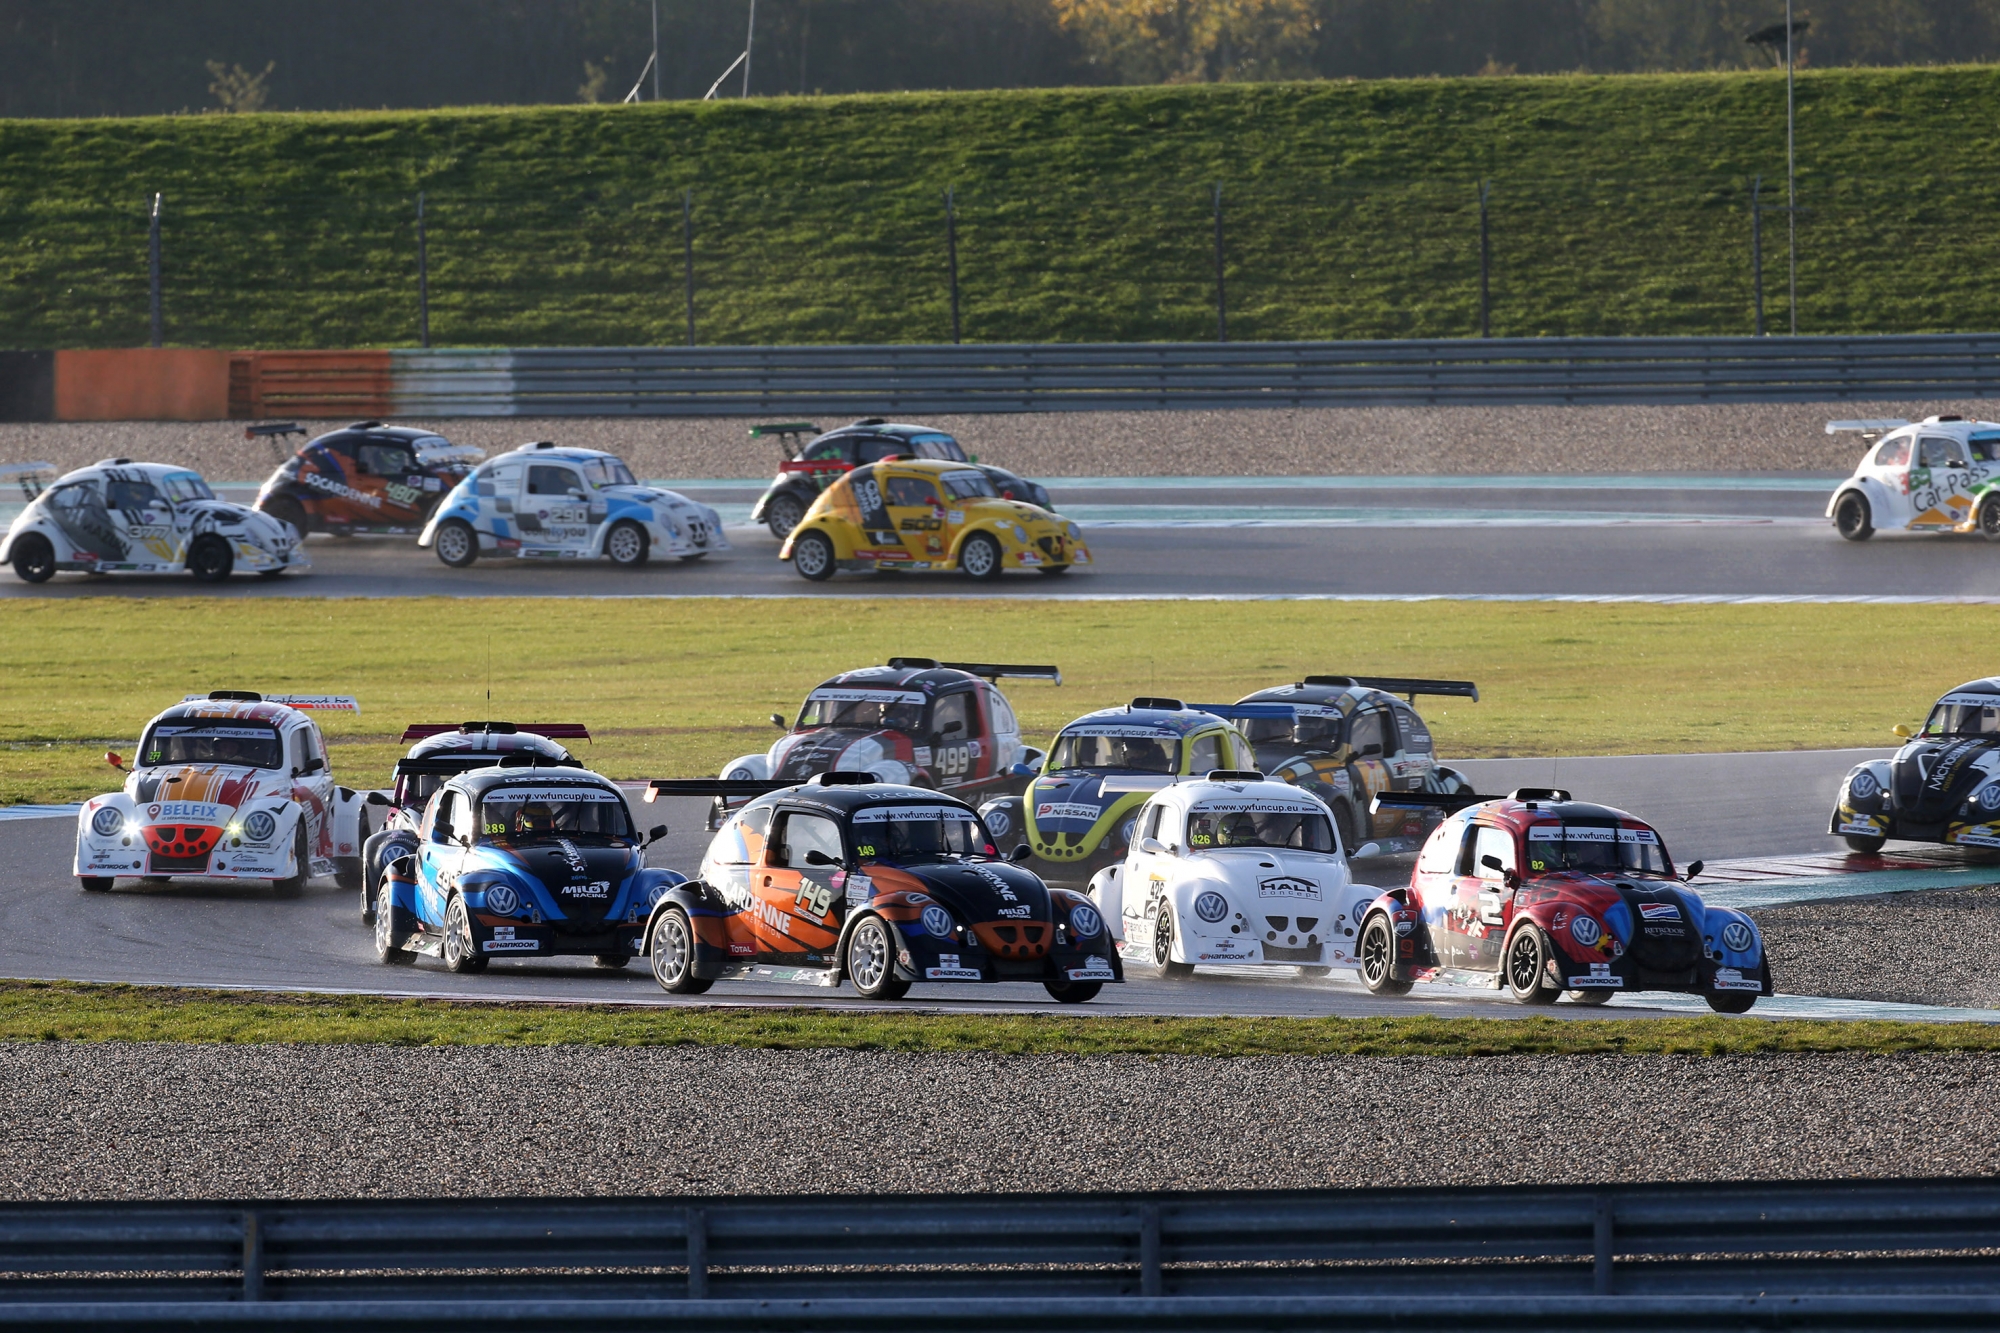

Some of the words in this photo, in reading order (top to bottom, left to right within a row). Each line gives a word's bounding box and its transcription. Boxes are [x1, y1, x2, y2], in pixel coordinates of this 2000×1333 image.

[1913, 465, 1990, 513] Car-Pass
[550, 508, 588, 524] 290
[129, 524, 171, 540] 377
[934, 746, 970, 775] 499
[162, 804, 218, 818] BELFIX
[1052, 808, 1098, 819] NISSAN
[1213, 803, 1299, 813] www.vwfuncup.eu
[484, 823, 506, 834] 289
[1192, 834, 1211, 845] 426
[857, 846, 876, 857] 149
[850, 883, 867, 892] TOTAL
[1260, 882, 1319, 894] HALL
[1261, 889, 1319, 899] concept
[486, 884, 518, 915] VW
[795, 877, 832, 918] 149
[1196, 892, 1227, 922] VW
[922, 906, 952, 938] VW
[1071, 905, 1100, 937] VW
[1571, 916, 1601, 946] VW
[1723, 923, 1752, 952] VW
[730, 944, 753, 954] TOTAL
